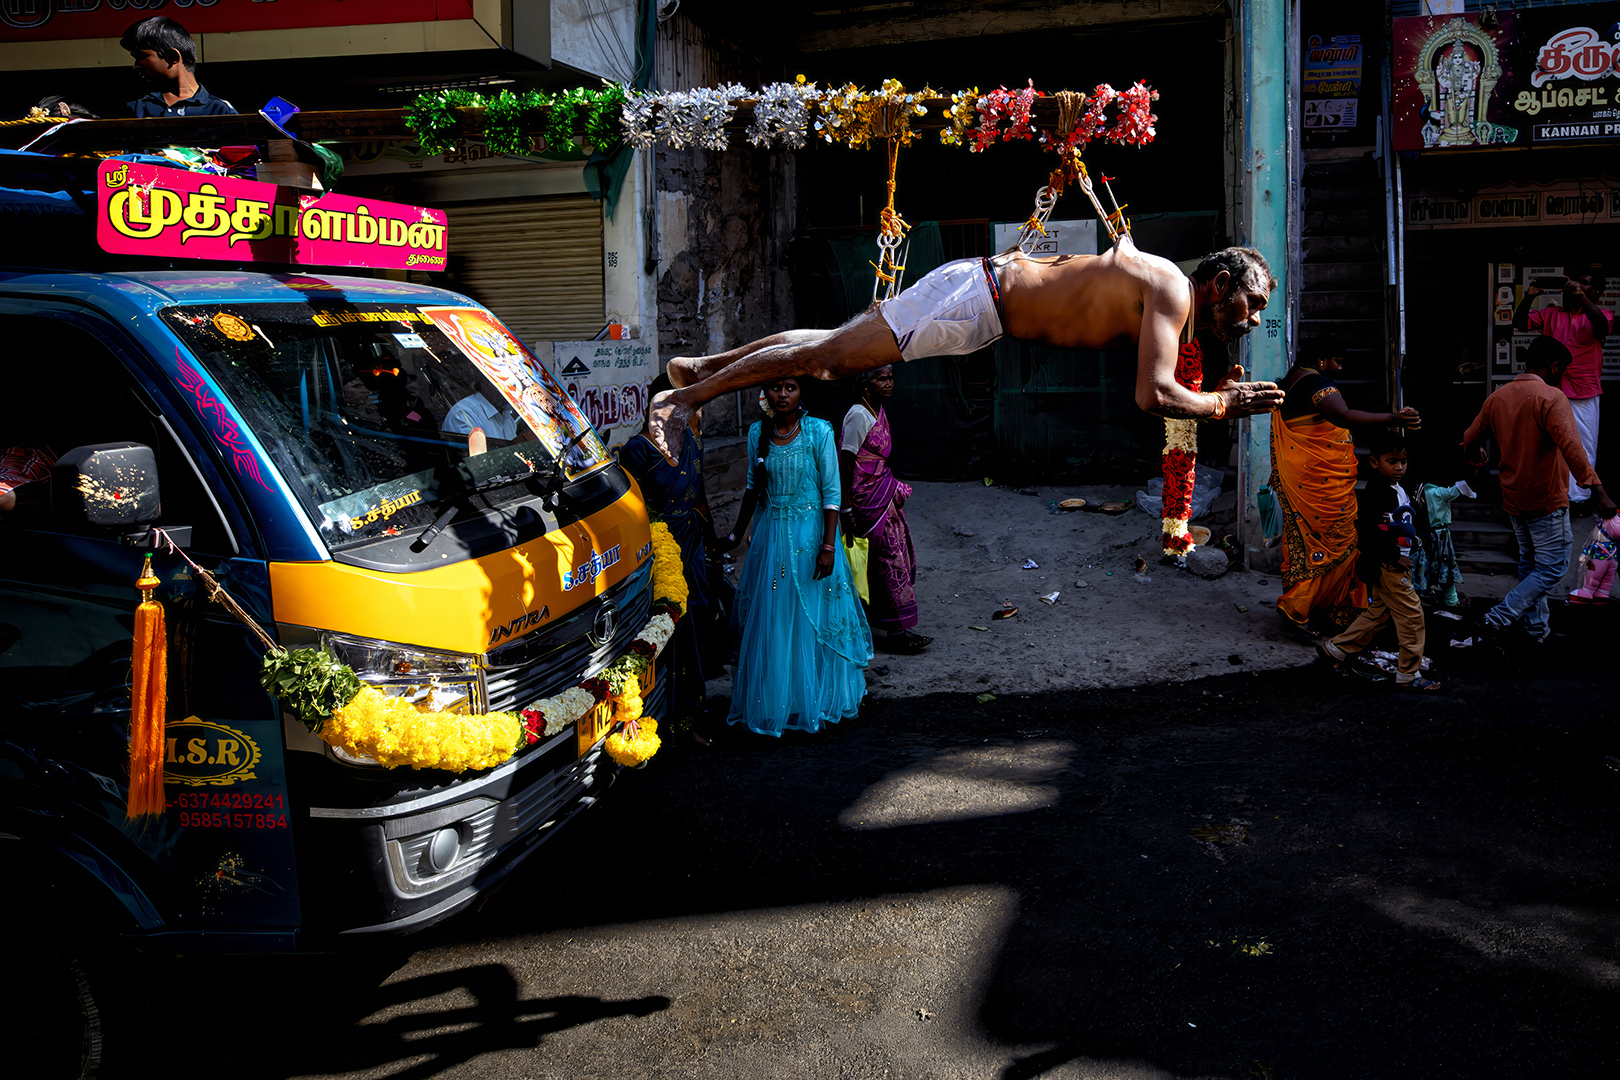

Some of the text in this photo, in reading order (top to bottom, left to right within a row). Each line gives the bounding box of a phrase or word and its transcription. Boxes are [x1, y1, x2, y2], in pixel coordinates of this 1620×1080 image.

[1514, 83, 1608, 115] ஆப்செட்
[1541, 124, 1600, 137] KANNAN
[108, 182, 446, 251] முத்தாளம்மன்
[405, 253, 446, 267] துணை
[1265, 319, 1281, 328] DBC
[487, 604, 550, 646] INTRA
[179, 811, 288, 830] 9585157854
